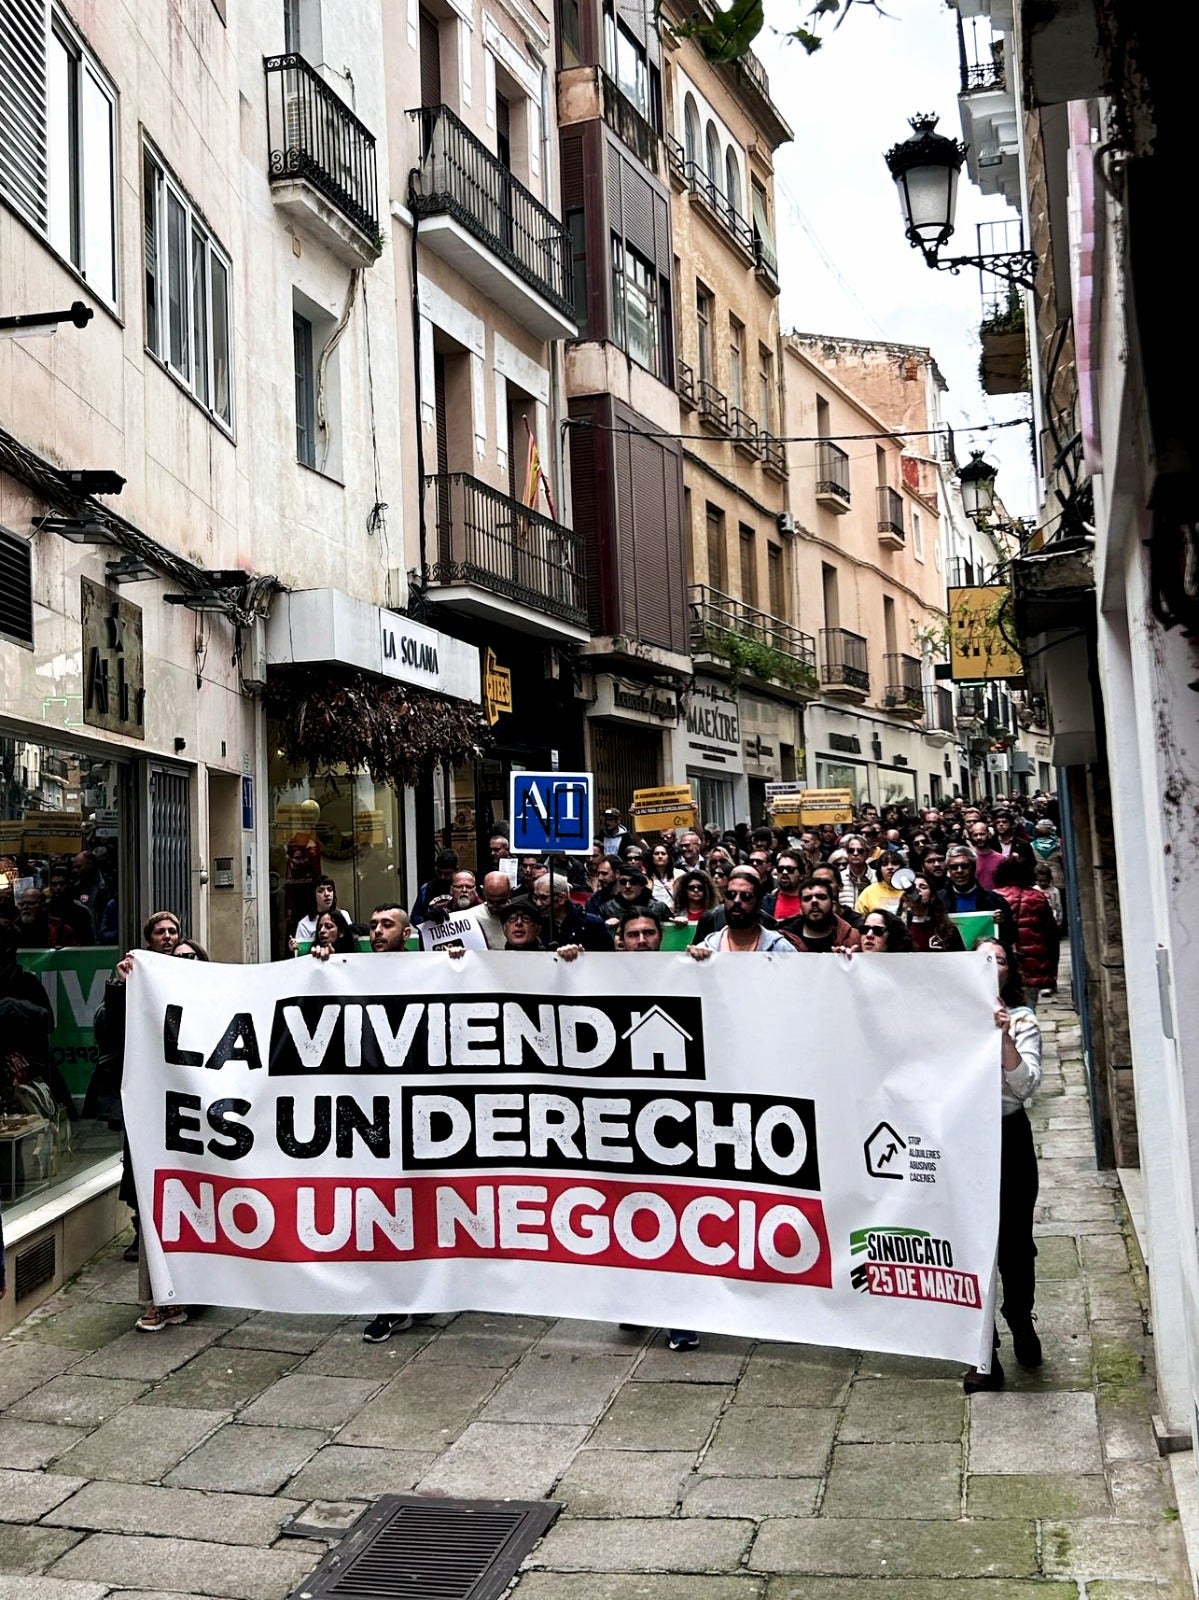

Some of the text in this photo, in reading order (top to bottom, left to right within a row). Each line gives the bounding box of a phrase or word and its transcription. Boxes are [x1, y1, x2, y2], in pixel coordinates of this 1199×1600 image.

[383, 629, 439, 674] LA SOLANA
[429, 919, 471, 941] TURISMO
[164, 1004, 262, 1070] LA
[165, 1090, 807, 1176] ES UN DERECHO
[162, 1179, 820, 1274] NO UN NEGOCIO
[867, 1233, 954, 1268] SINDICATO
[869, 1266, 977, 1305] 25 DE MARZO
